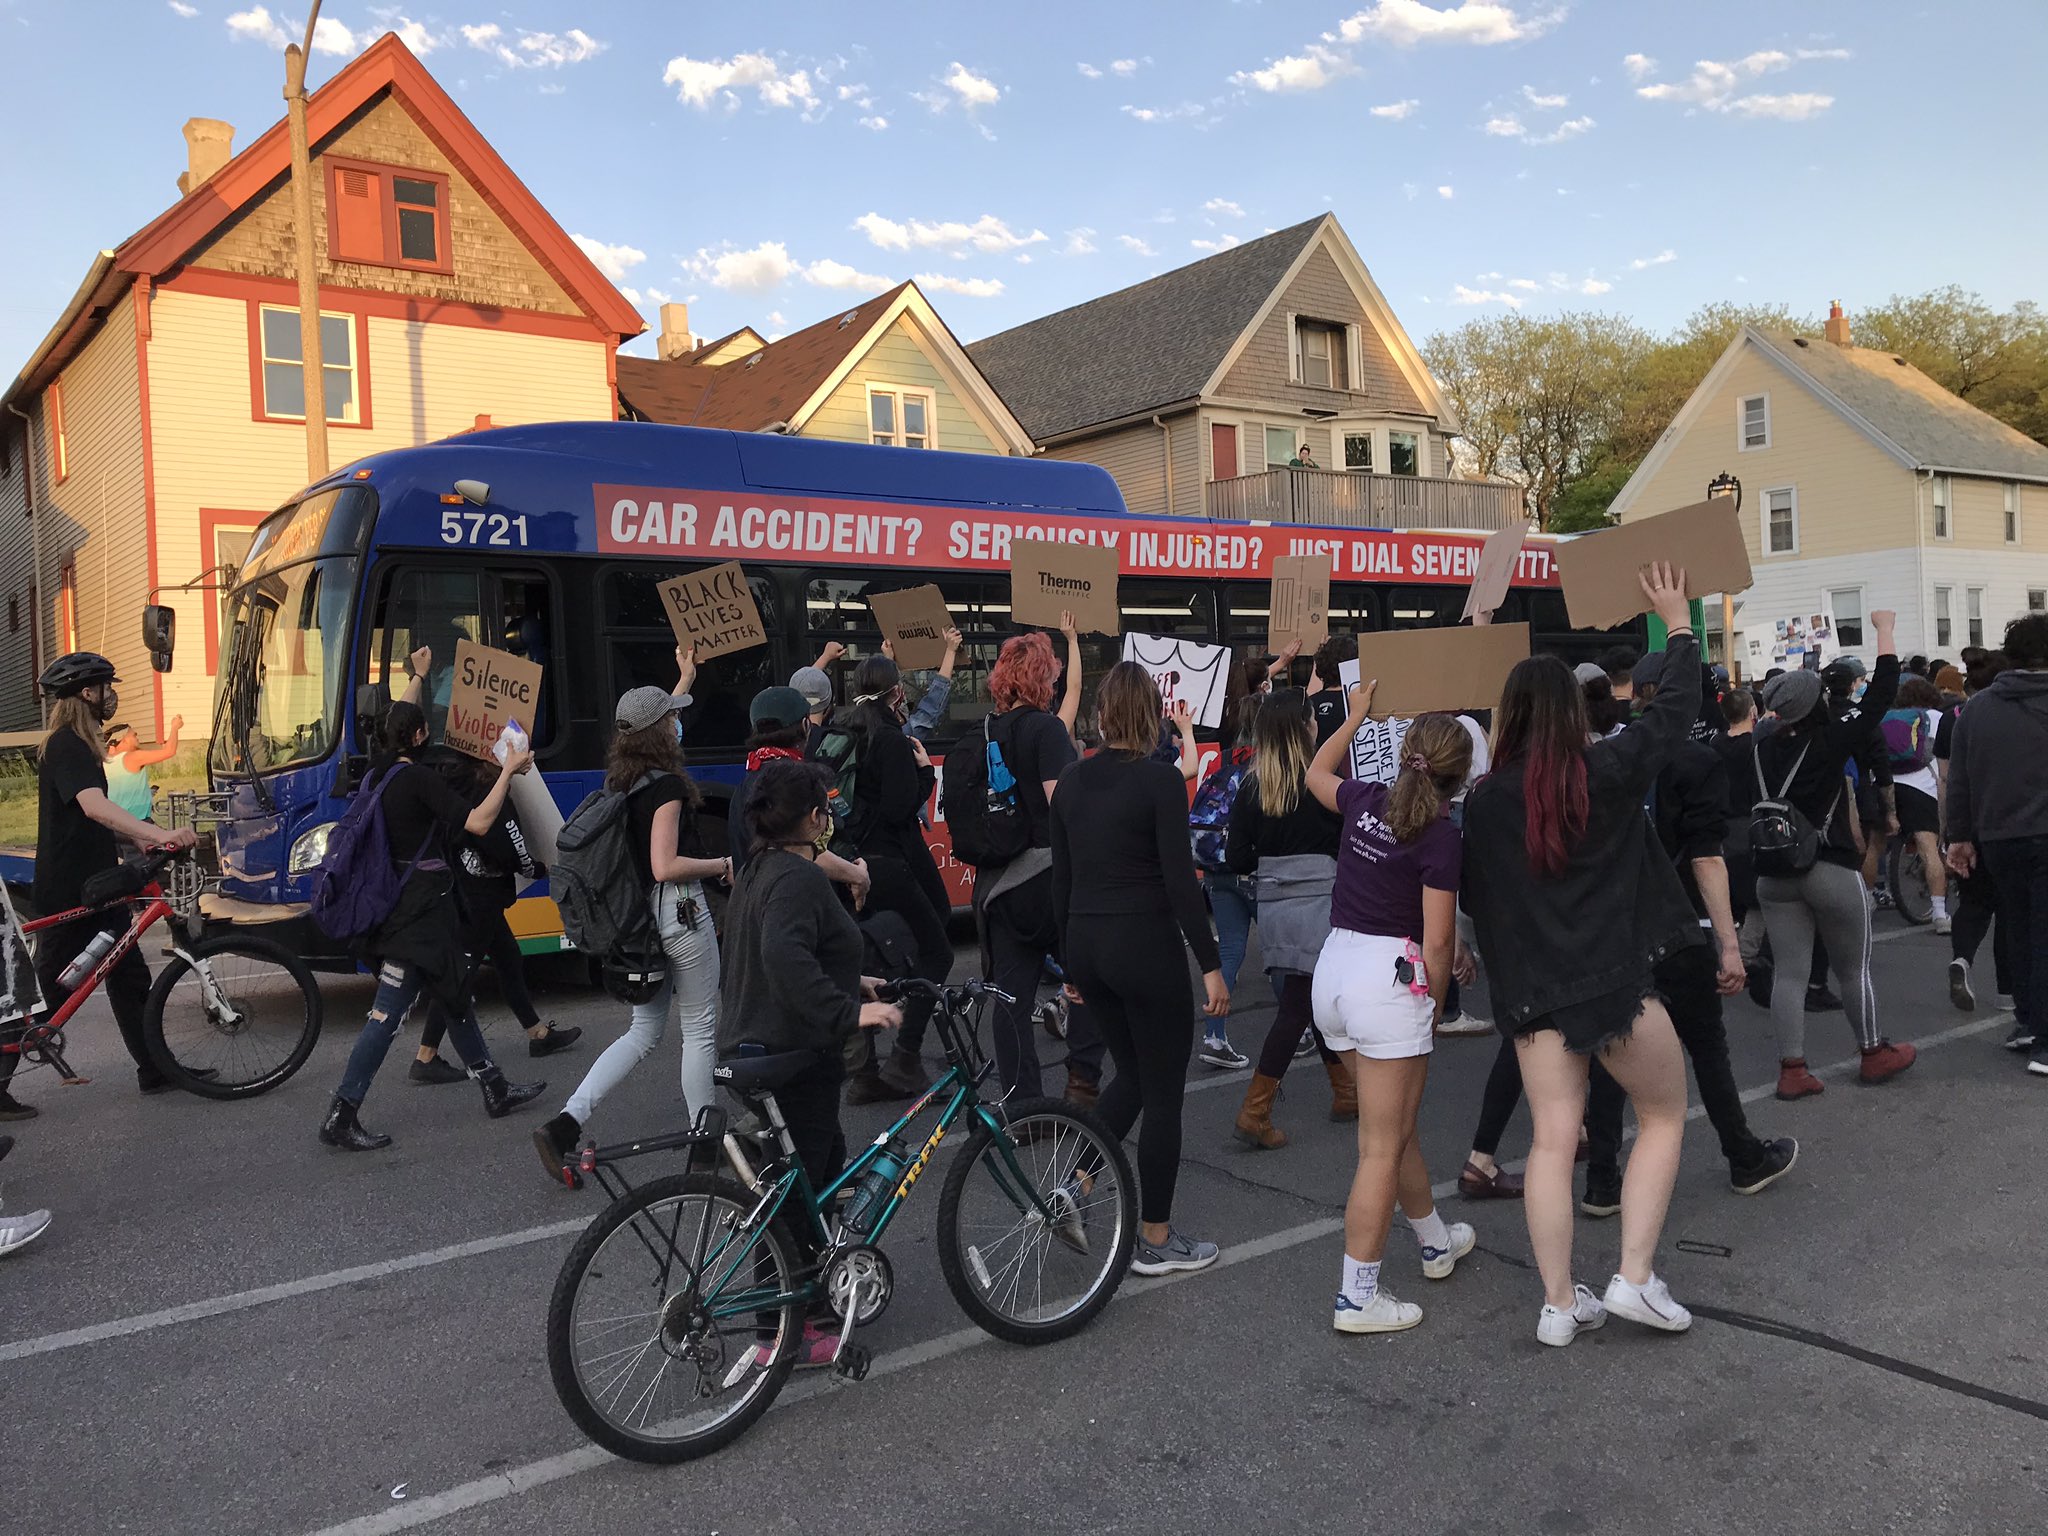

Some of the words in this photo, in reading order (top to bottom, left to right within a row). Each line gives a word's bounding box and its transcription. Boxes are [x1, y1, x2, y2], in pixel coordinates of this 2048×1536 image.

[441, 511, 527, 546] 5721
[610, 499, 698, 545] CAR
[709, 505, 923, 556] ACCIDENT?
[1130, 531, 1264, 569] INJURED?
[1352, 541, 1403, 574] DIAL
[668, 570, 745, 613] BLACK
[1038, 571, 1091, 592] Thermo
[1041, 587, 1090, 600] SCIENTIFIC
[683, 604, 743, 633] LIVES
[898, 627, 938, 640] Thermo
[694, 624, 759, 654] MATTER
[462, 657, 530, 704] Silence
[1377, 719, 1394, 773] SILENCE
[894, 1122, 947, 1199] TREK
